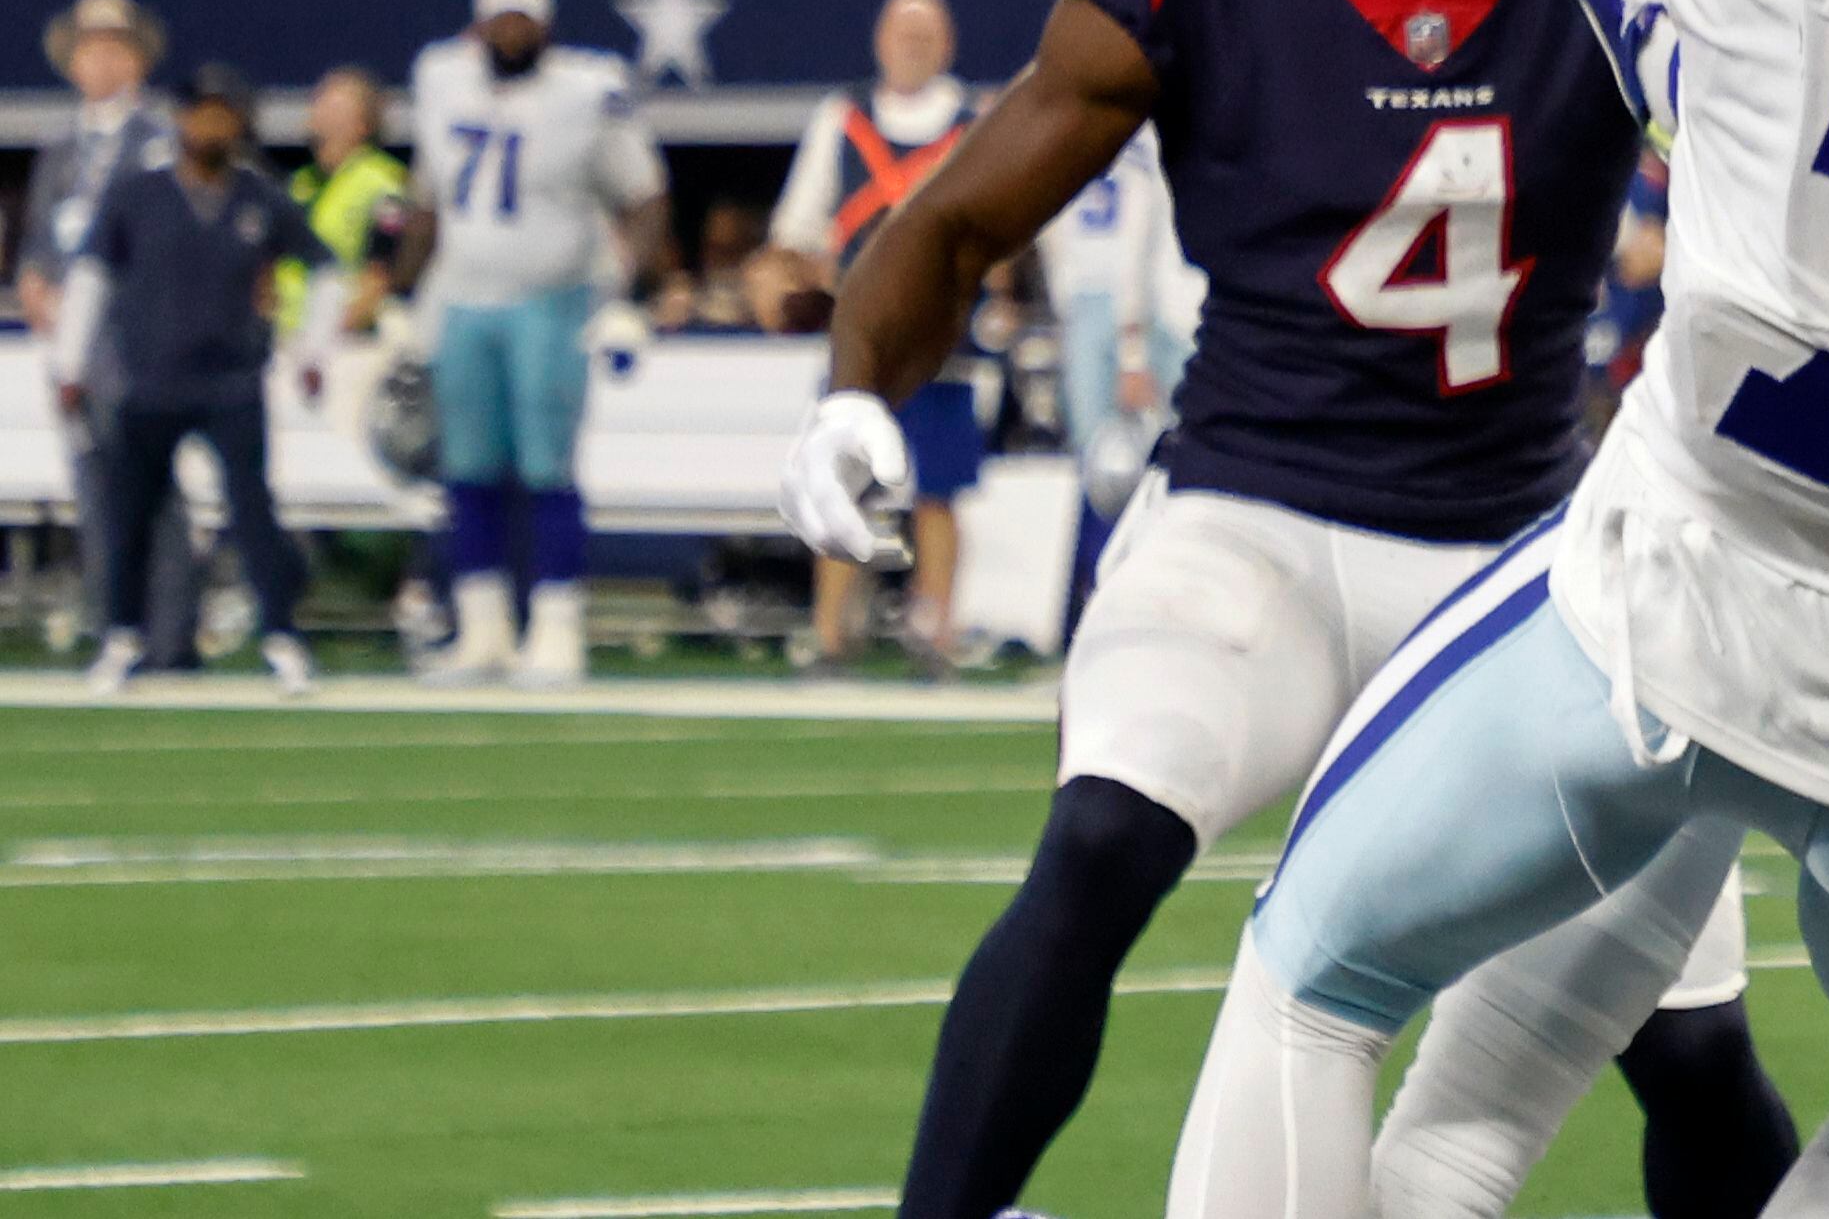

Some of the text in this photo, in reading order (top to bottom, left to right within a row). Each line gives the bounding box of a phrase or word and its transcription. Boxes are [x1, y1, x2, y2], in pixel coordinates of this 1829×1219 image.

[1364, 85, 1495, 110] TEXANS
[449, 125, 522, 217] 71
[1315, 114, 1538, 400] 4
